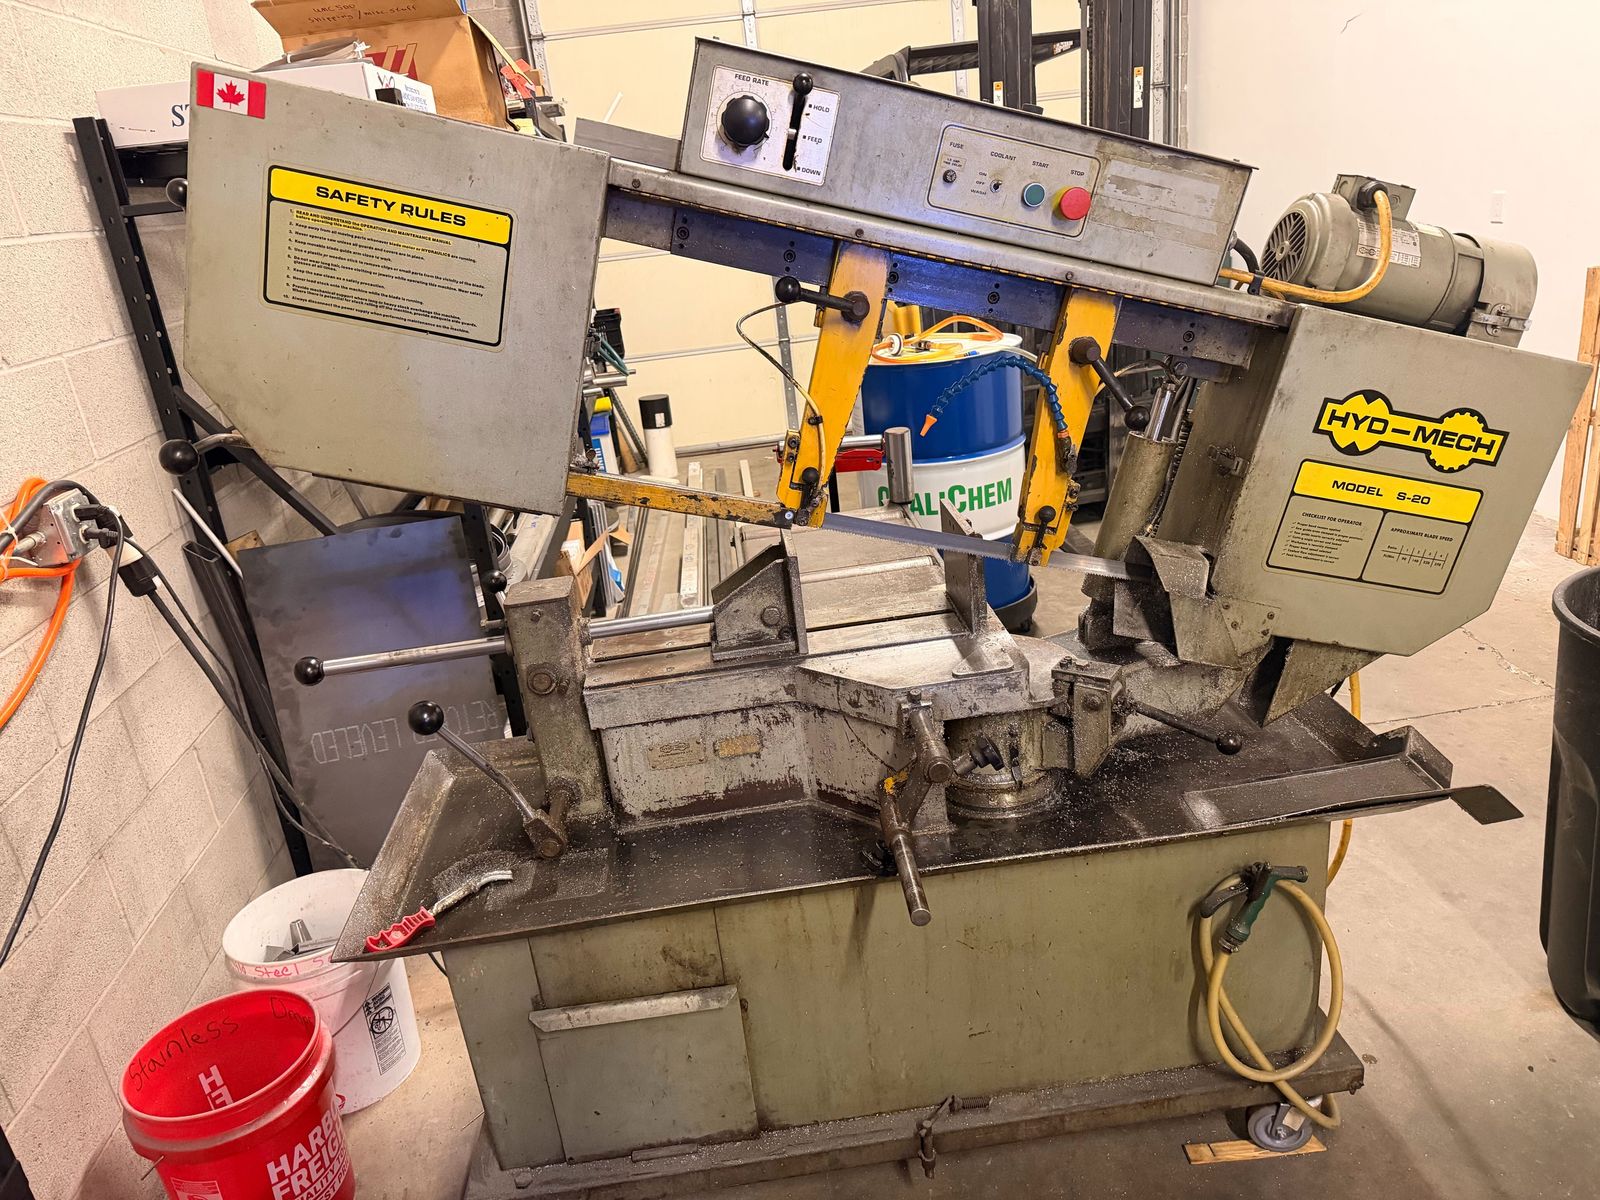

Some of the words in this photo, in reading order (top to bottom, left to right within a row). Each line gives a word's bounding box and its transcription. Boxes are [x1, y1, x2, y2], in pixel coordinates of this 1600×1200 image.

[735, 74, 751, 82] FEED
[752, 78, 769, 86] RATE
[990, 151, 1016, 161] COOLANT
[316, 186, 396, 211] SAFETY
[401, 204, 466, 226] RULES
[320, 215, 351, 224] UNDERSTAND
[360, 223, 386, 231] OPERATION
[397, 231, 430, 240] MAINTENANCE
[421, 248, 450, 257] HYDRAULICS
[1332, 480, 1383, 496] MODEL
[1396, 492, 1431, 504] S-20
[1337, 518, 1362, 526] OPERATOR
[1390, 527, 1423, 536] APPROXIMATE
[311, 718, 400, 764] LEVELED
[255, 964, 299, 977] Steel
[129, 1017, 238, 1091] Stainless
[267, 1096, 338, 1184] HARBO
[272, 1113, 343, 1200] FREIGH
[300, 1165, 334, 1200] ALITY
